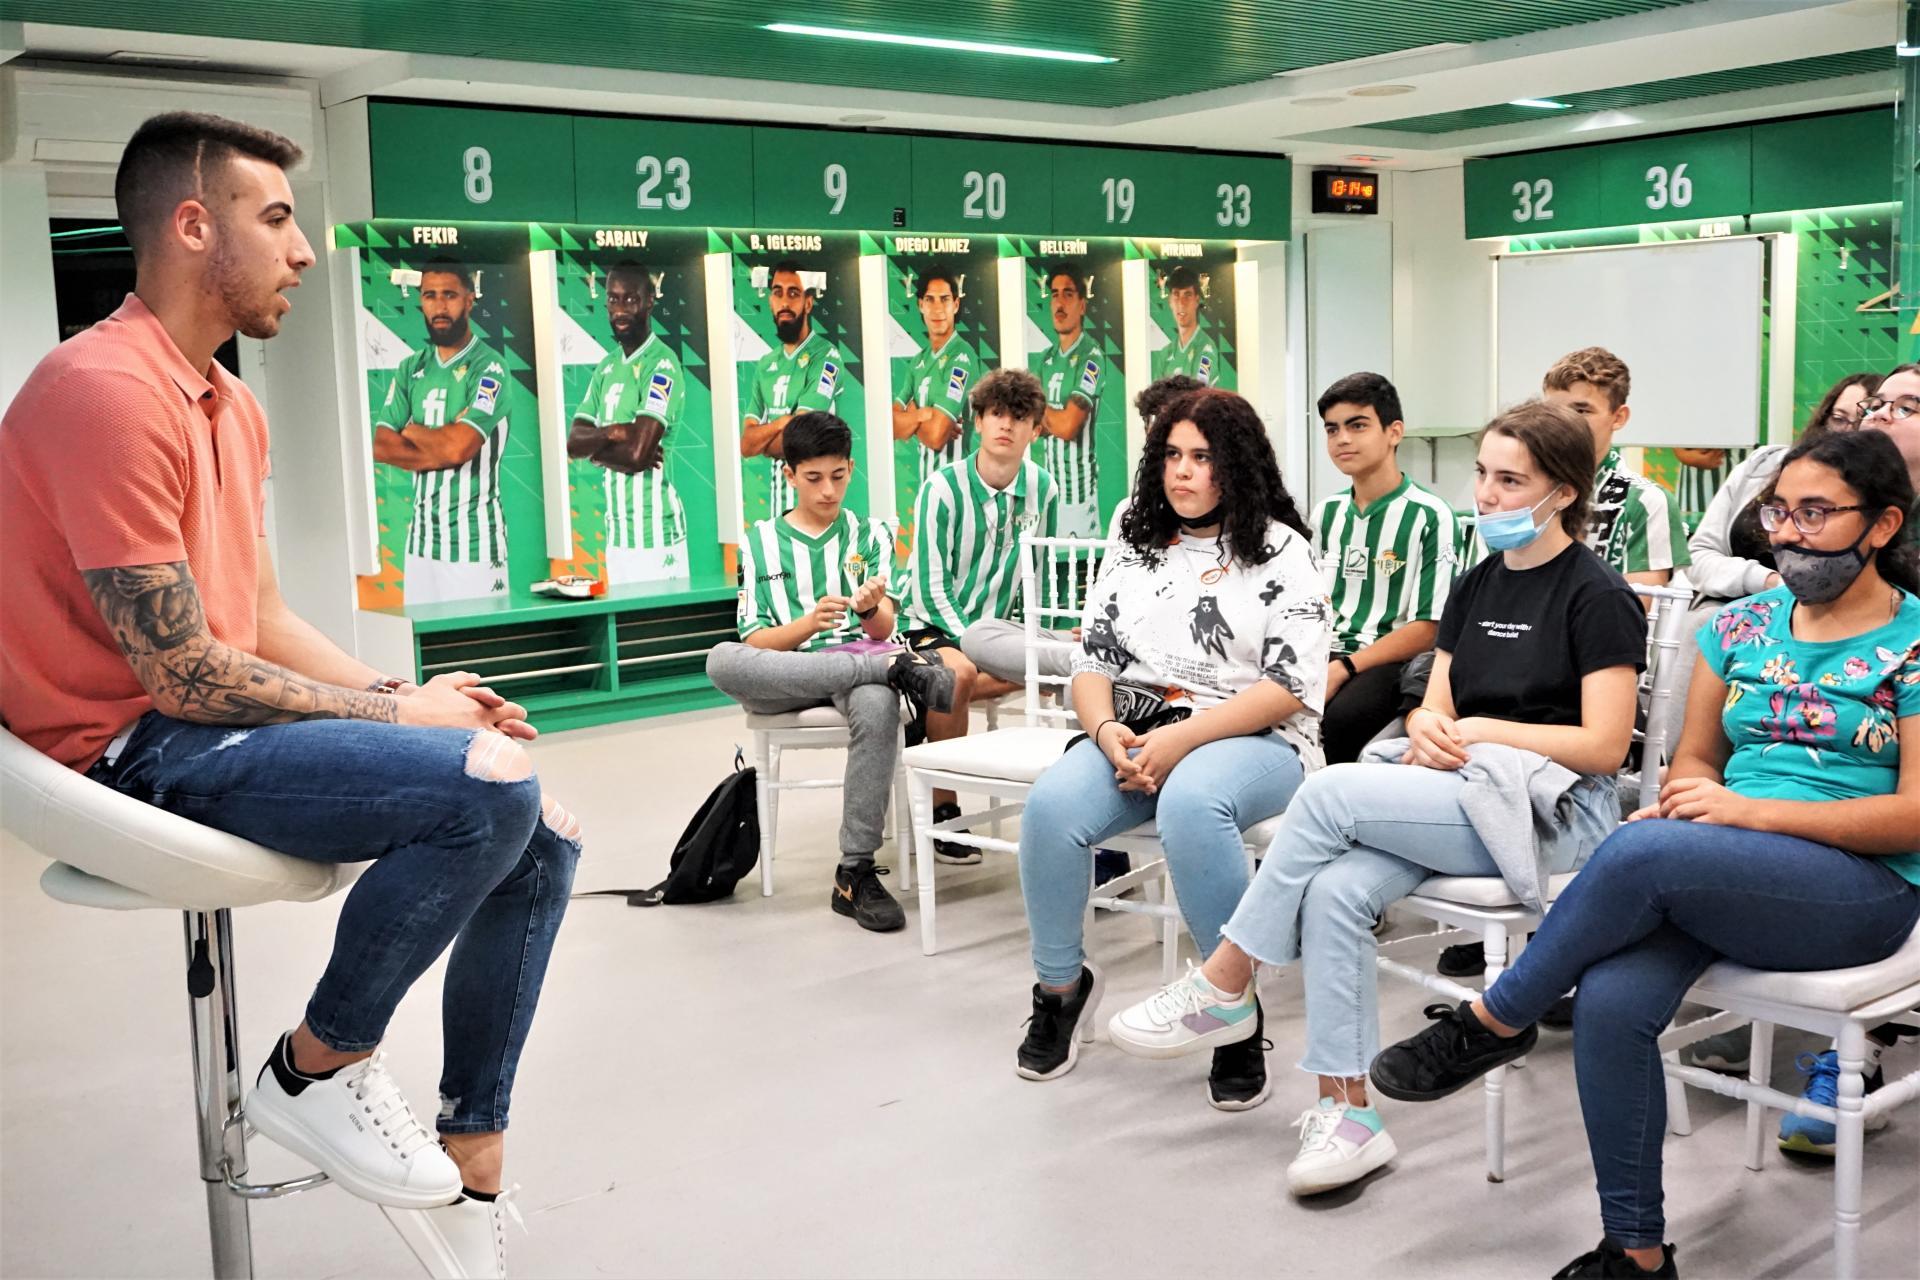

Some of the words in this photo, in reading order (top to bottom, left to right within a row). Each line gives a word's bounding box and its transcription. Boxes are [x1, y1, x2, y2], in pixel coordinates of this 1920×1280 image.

[463, 146, 493, 204] 8
[636, 156, 692, 211] 23
[824, 164, 848, 215] 9
[963, 171, 1006, 220] 20
[1646, 163, 1693, 210] 36
[1102, 178, 1135, 224] 19
[1217, 184, 1252, 227] 33
[1513, 178, 1554, 223] 32
[413, 227, 458, 244] FEKIR
[596, 230, 648, 248] SABALY
[751, 235, 764, 250] B.
[766, 235, 822, 251] IGLESIAS
[896, 237, 930, 253] DIEGO
[931, 238, 970, 254] LAINEZ
[1040, 239, 1088, 255] BELLERÍN
[1161, 243, 1203, 257] MIRANDA
